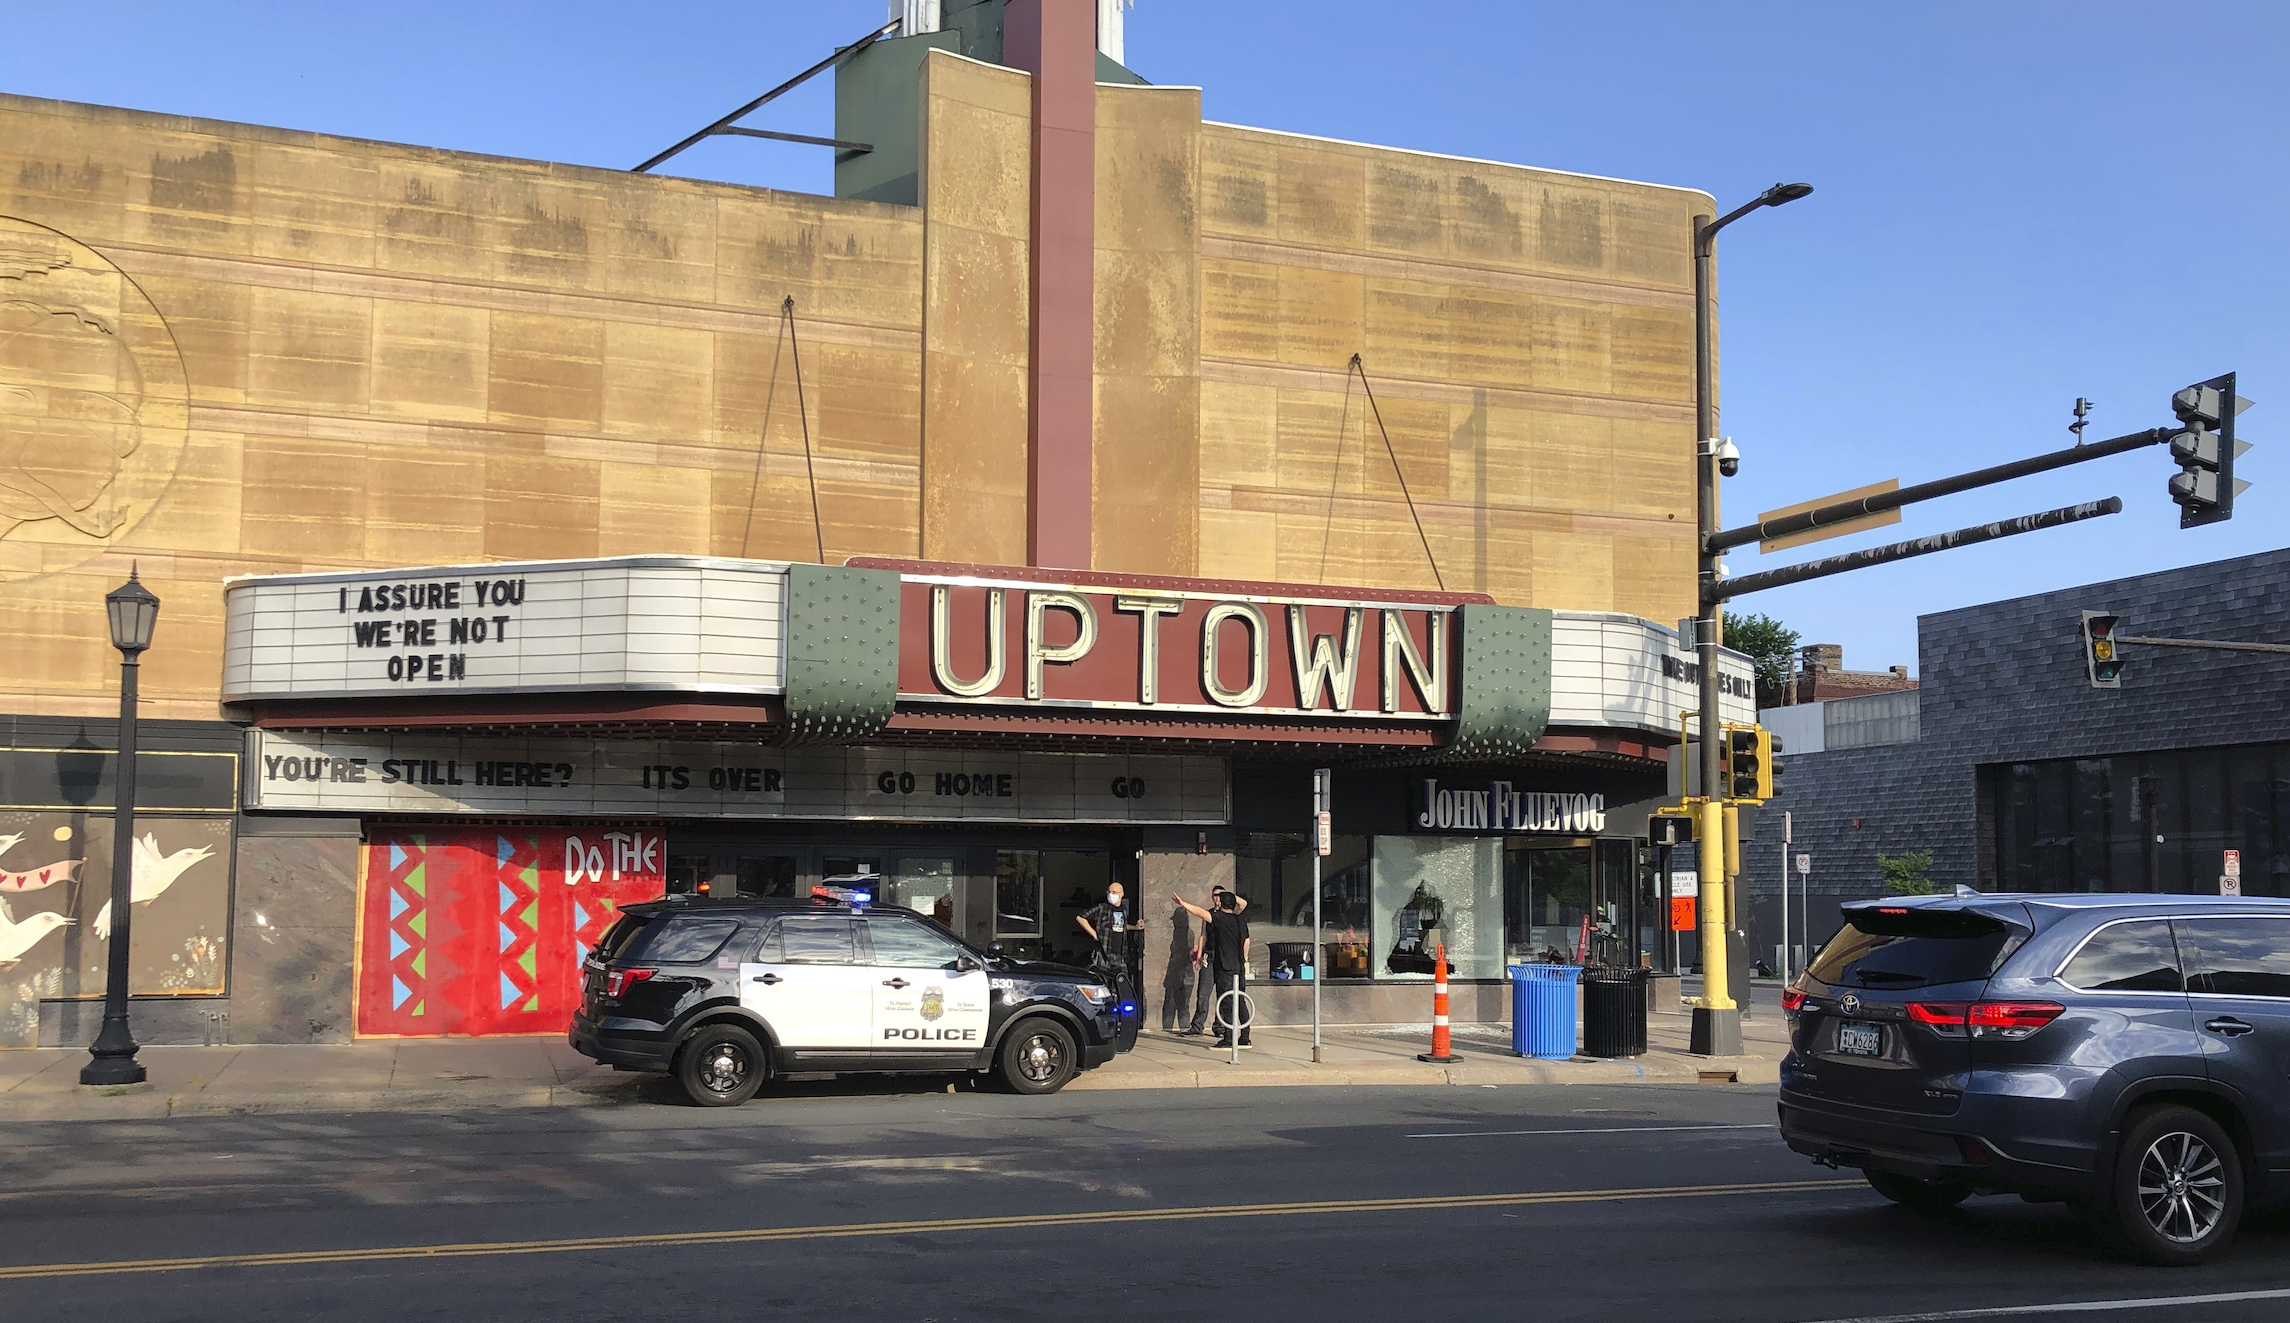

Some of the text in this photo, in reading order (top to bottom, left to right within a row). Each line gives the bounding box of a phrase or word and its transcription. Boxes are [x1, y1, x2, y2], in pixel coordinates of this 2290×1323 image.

[340, 578, 526, 613] I ASSURE YOU
[354, 615, 511, 648] WE'RE NOT
[932, 584, 1450, 714] UPTOWN
[387, 653, 466, 682] OPEN
[264, 754, 574, 788] YOU'RE STILL HERE?
[642, 764, 782, 792] ITS OVER
[878, 771, 1013, 798] GO HOME
[1110, 775, 1146, 799] GO
[1420, 779, 1606, 832] JOHN FLUEVOG
[603, 831, 659, 881] THE
[991, 978, 1014, 989] 530
[884, 1028, 976, 1041] POLICE
